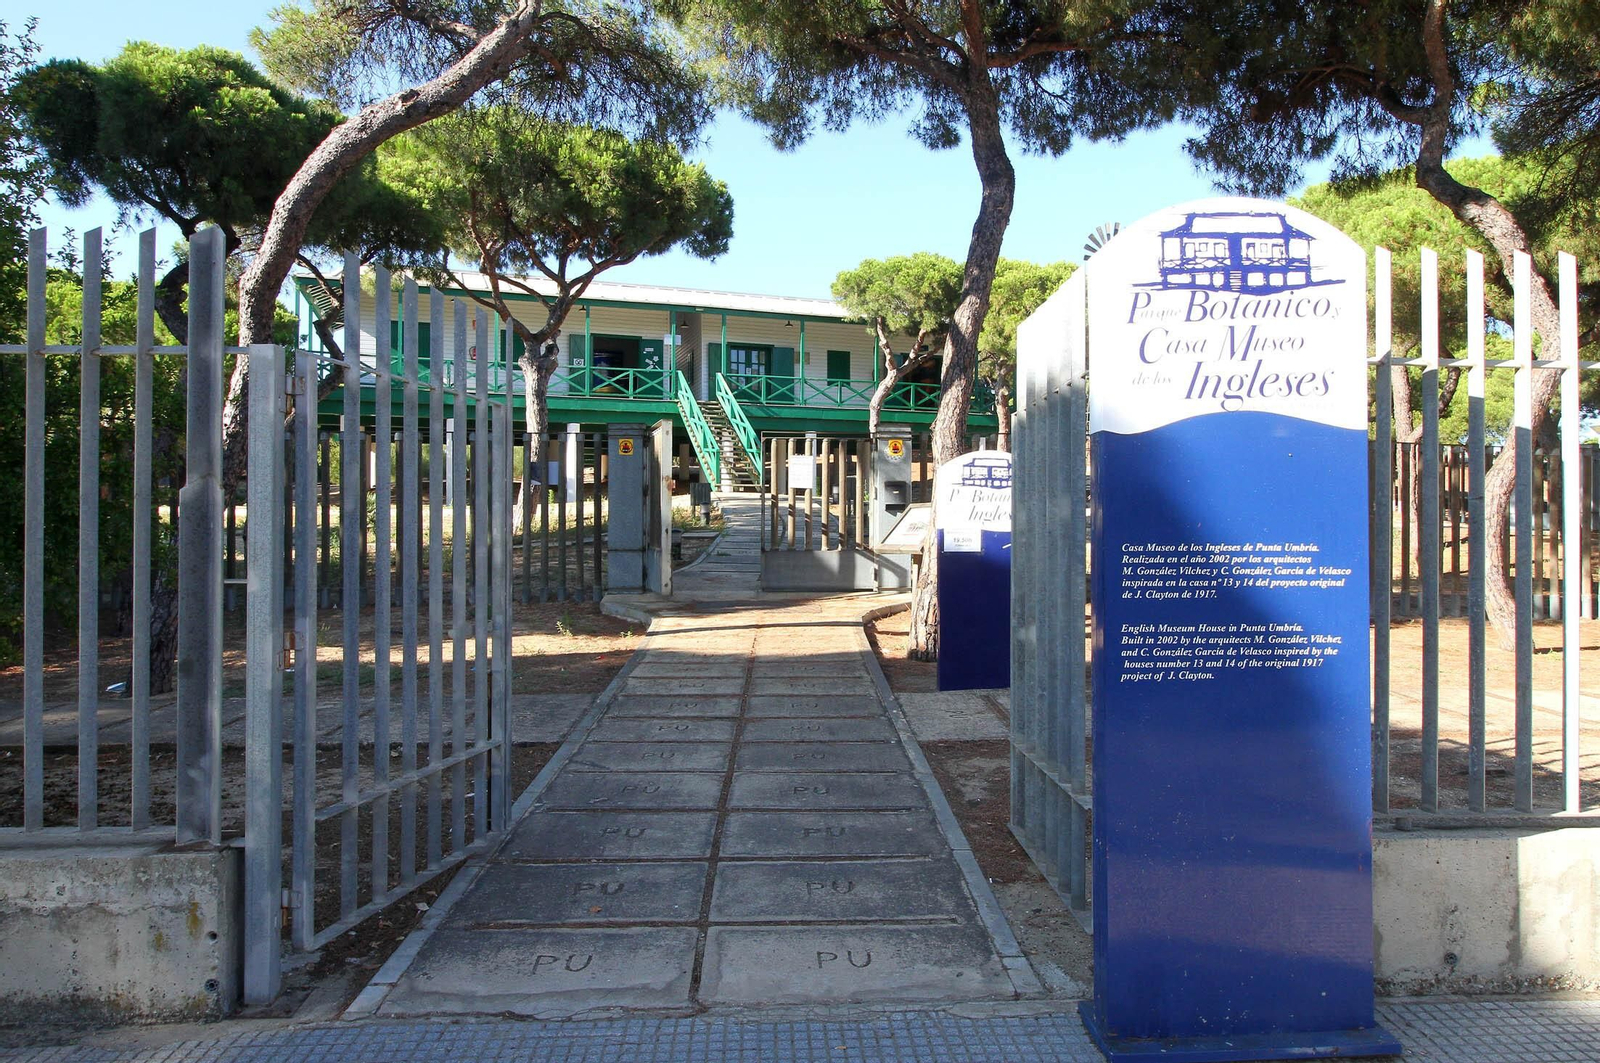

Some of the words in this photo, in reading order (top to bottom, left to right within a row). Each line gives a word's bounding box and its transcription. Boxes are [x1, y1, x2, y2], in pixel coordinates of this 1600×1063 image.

[1139, 327, 1207, 365] Casa
[1217, 325, 1304, 361] Museo
[1132, 372, 1150, 386] de
[1153, 371, 1172, 386] los
[1184, 359, 1335, 412] Ingleses
[1122, 543, 1143, 552] Casa
[1146, 543, 1175, 552] Museo
[1177, 543, 1188, 552] de
[1190, 543, 1203, 552] los
[1205, 543, 1241, 554] Ingleses
[1243, 543, 1253, 552] de
[1255, 543, 1282, 552] Punta
[1285, 543, 1320, 552] Umbría.
[1122, 555, 1164, 564] Realizada
[1180, 555, 1188, 563] el
[1190, 555, 1207, 563] año
[1209, 555, 1229, 563] 2002
[1231, 557, 1247, 565] por
[1249, 555, 1261, 563] los
[1264, 555, 1312, 565] arquitectos
[1122, 567, 1134, 575] M.
[1137, 566, 1177, 575] González
[1212, 568, 1218, 577] y
[1221, 566, 1229, 575] C.
[1232, 566, 1272, 575] González
[1274, 567, 1304, 575] García
[1306, 567, 1316, 575] de
[1319, 567, 1352, 575] Velasco
[1122, 578, 1163, 588] inspirada
[1178, 578, 1187, 586] la
[1223, 578, 1233, 586] 13
[1235, 580, 1241, 588] y
[1243, 578, 1253, 586] 14
[1255, 578, 1268, 586] del
[1270, 579, 1308, 588] proyecto
[1310, 578, 1345, 588] original
[1122, 590, 1133, 598] de
[1134, 590, 1142, 598] J.
[1145, 590, 1179, 600] Clayton
[1181, 590, 1192, 598] de
[1195, 590, 1217, 598] 1917.
[1121, 624, 1155, 634] English
[1158, 624, 1195, 632] Museum
[1198, 624, 1226, 632] House
[1229, 624, 1237, 632] in
[1239, 624, 1266, 632] Punta
[1269, 624, 1304, 632] Umbría.
[1121, 636, 1143, 644] Built
[1145, 636, 1154, 644] in
[1157, 636, 1178, 644] 2002
[1180, 636, 1190, 646] by
[1193, 636, 1206, 644] the
[1209, 636, 1251, 645] arquitects
[1253, 635, 1265, 644] M.
[1268, 635, 1308, 644] González
[1121, 648, 1138, 656] and
[1141, 648, 1150, 656] C.
[1153, 648, 1193, 656] González
[1195, 648, 1224, 656] García
[1226, 648, 1237, 656] de
[1240, 647, 1272, 655] Velasco
[1274, 647, 1310, 657] inspired
[1312, 647, 1322, 657] by
[1324, 647, 1338, 655] the
[1124, 660, 1154, 668] houses
[1156, 660, 1191, 668] number
[1193, 659, 1203, 668] 13
[1206, 659, 1222, 667] and
[1225, 659, 1235, 667] 14
[1237, 659, 1248, 669] of
[1249, 659, 1262, 667] the
[1265, 659, 1299, 669] original
[1302, 658, 1324, 667] 1917
[1121, 672, 1152, 682] project
[1154, 671, 1165, 681] of
[1168, 672, 1176, 680] J.
[1178, 671, 1214, 681] Clayton.
[793, 786, 831, 795] PU
[601, 827, 647, 839] PU
[802, 827, 847, 838] PU
[572, 882, 626, 896] PU
[805, 880, 856, 895] PU
[531, 953, 594, 975] PU
[815, 950, 873, 970] PU
